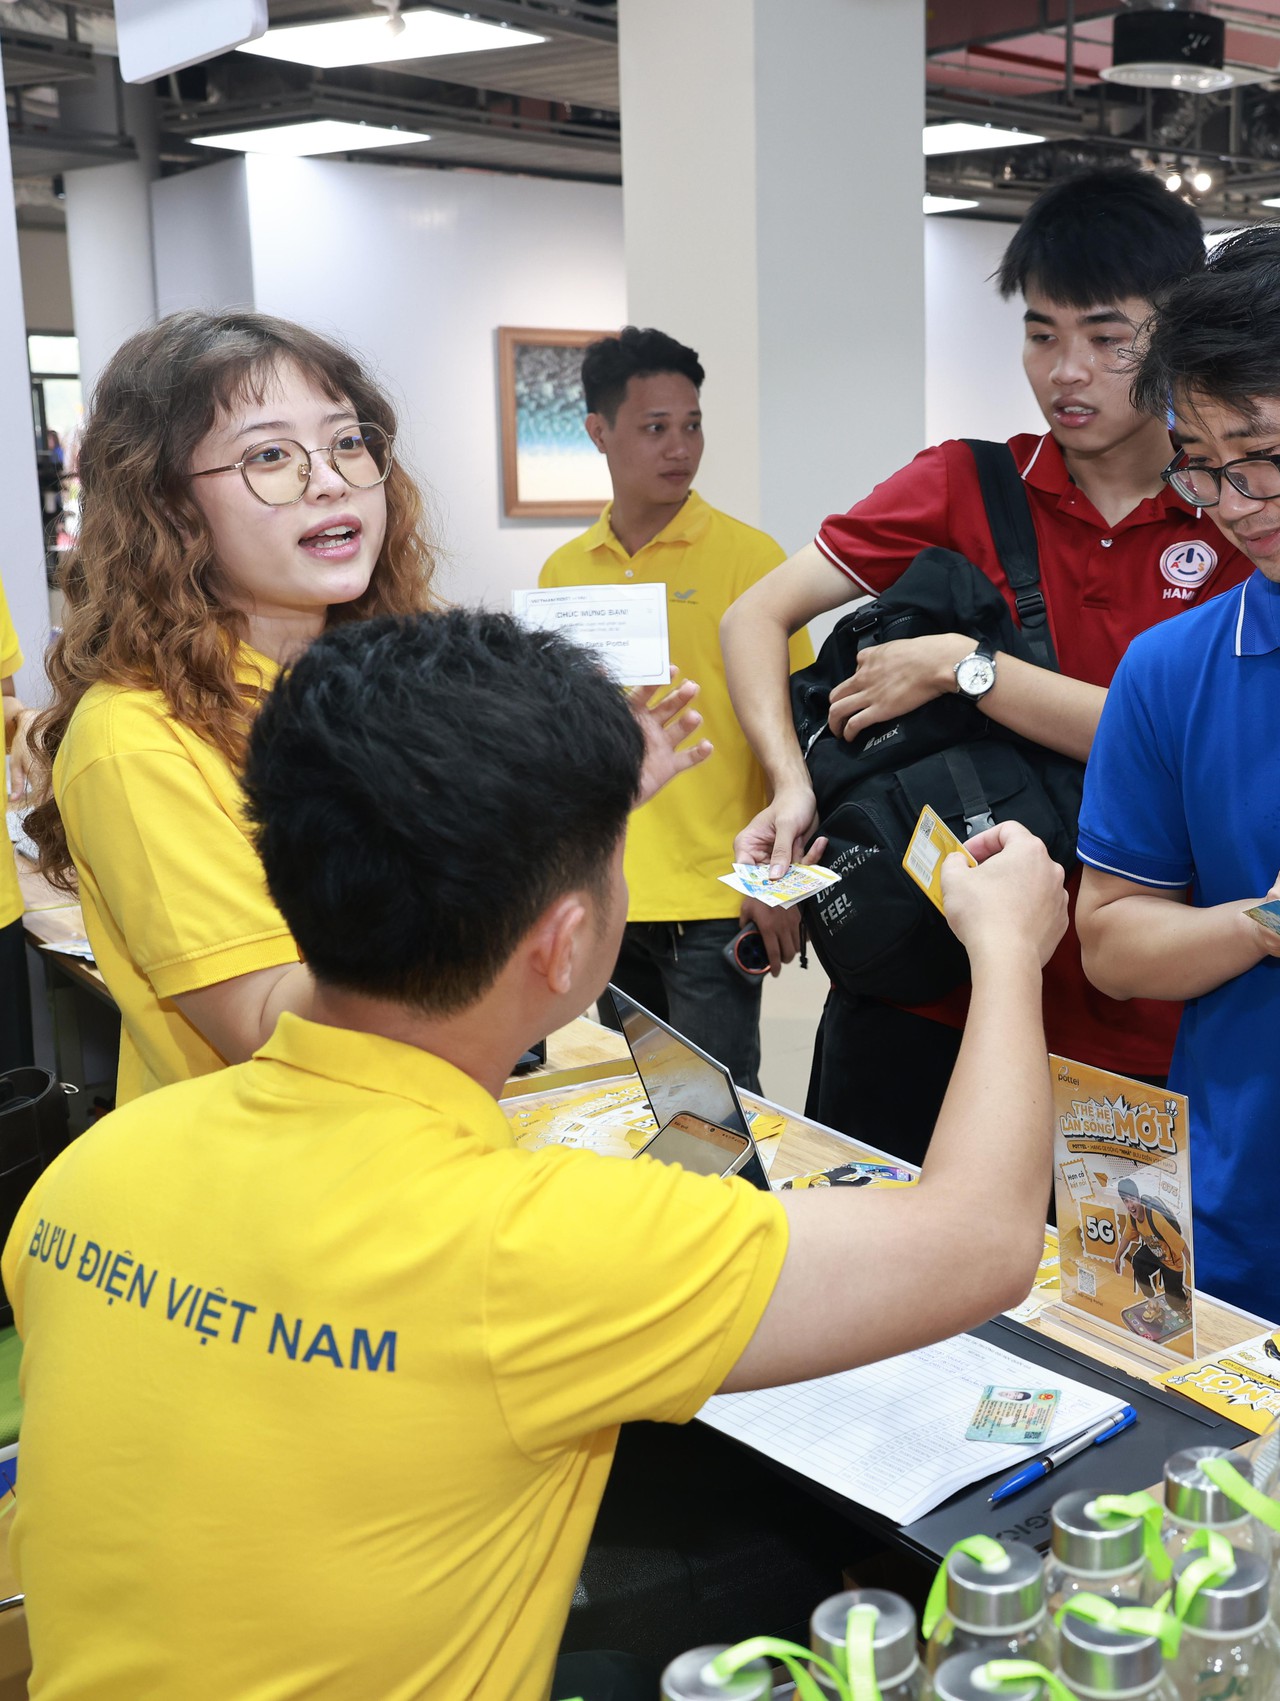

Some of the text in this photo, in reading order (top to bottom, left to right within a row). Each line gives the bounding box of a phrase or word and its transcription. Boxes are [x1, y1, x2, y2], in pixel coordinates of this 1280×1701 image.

[820, 893, 852, 926] FEEL
[1112, 1103, 1175, 1149] MỚI
[1086, 1215, 1115, 1245] 5G
[29, 1218, 398, 1373] BƯU ĐIỆN VIỆT NAM
